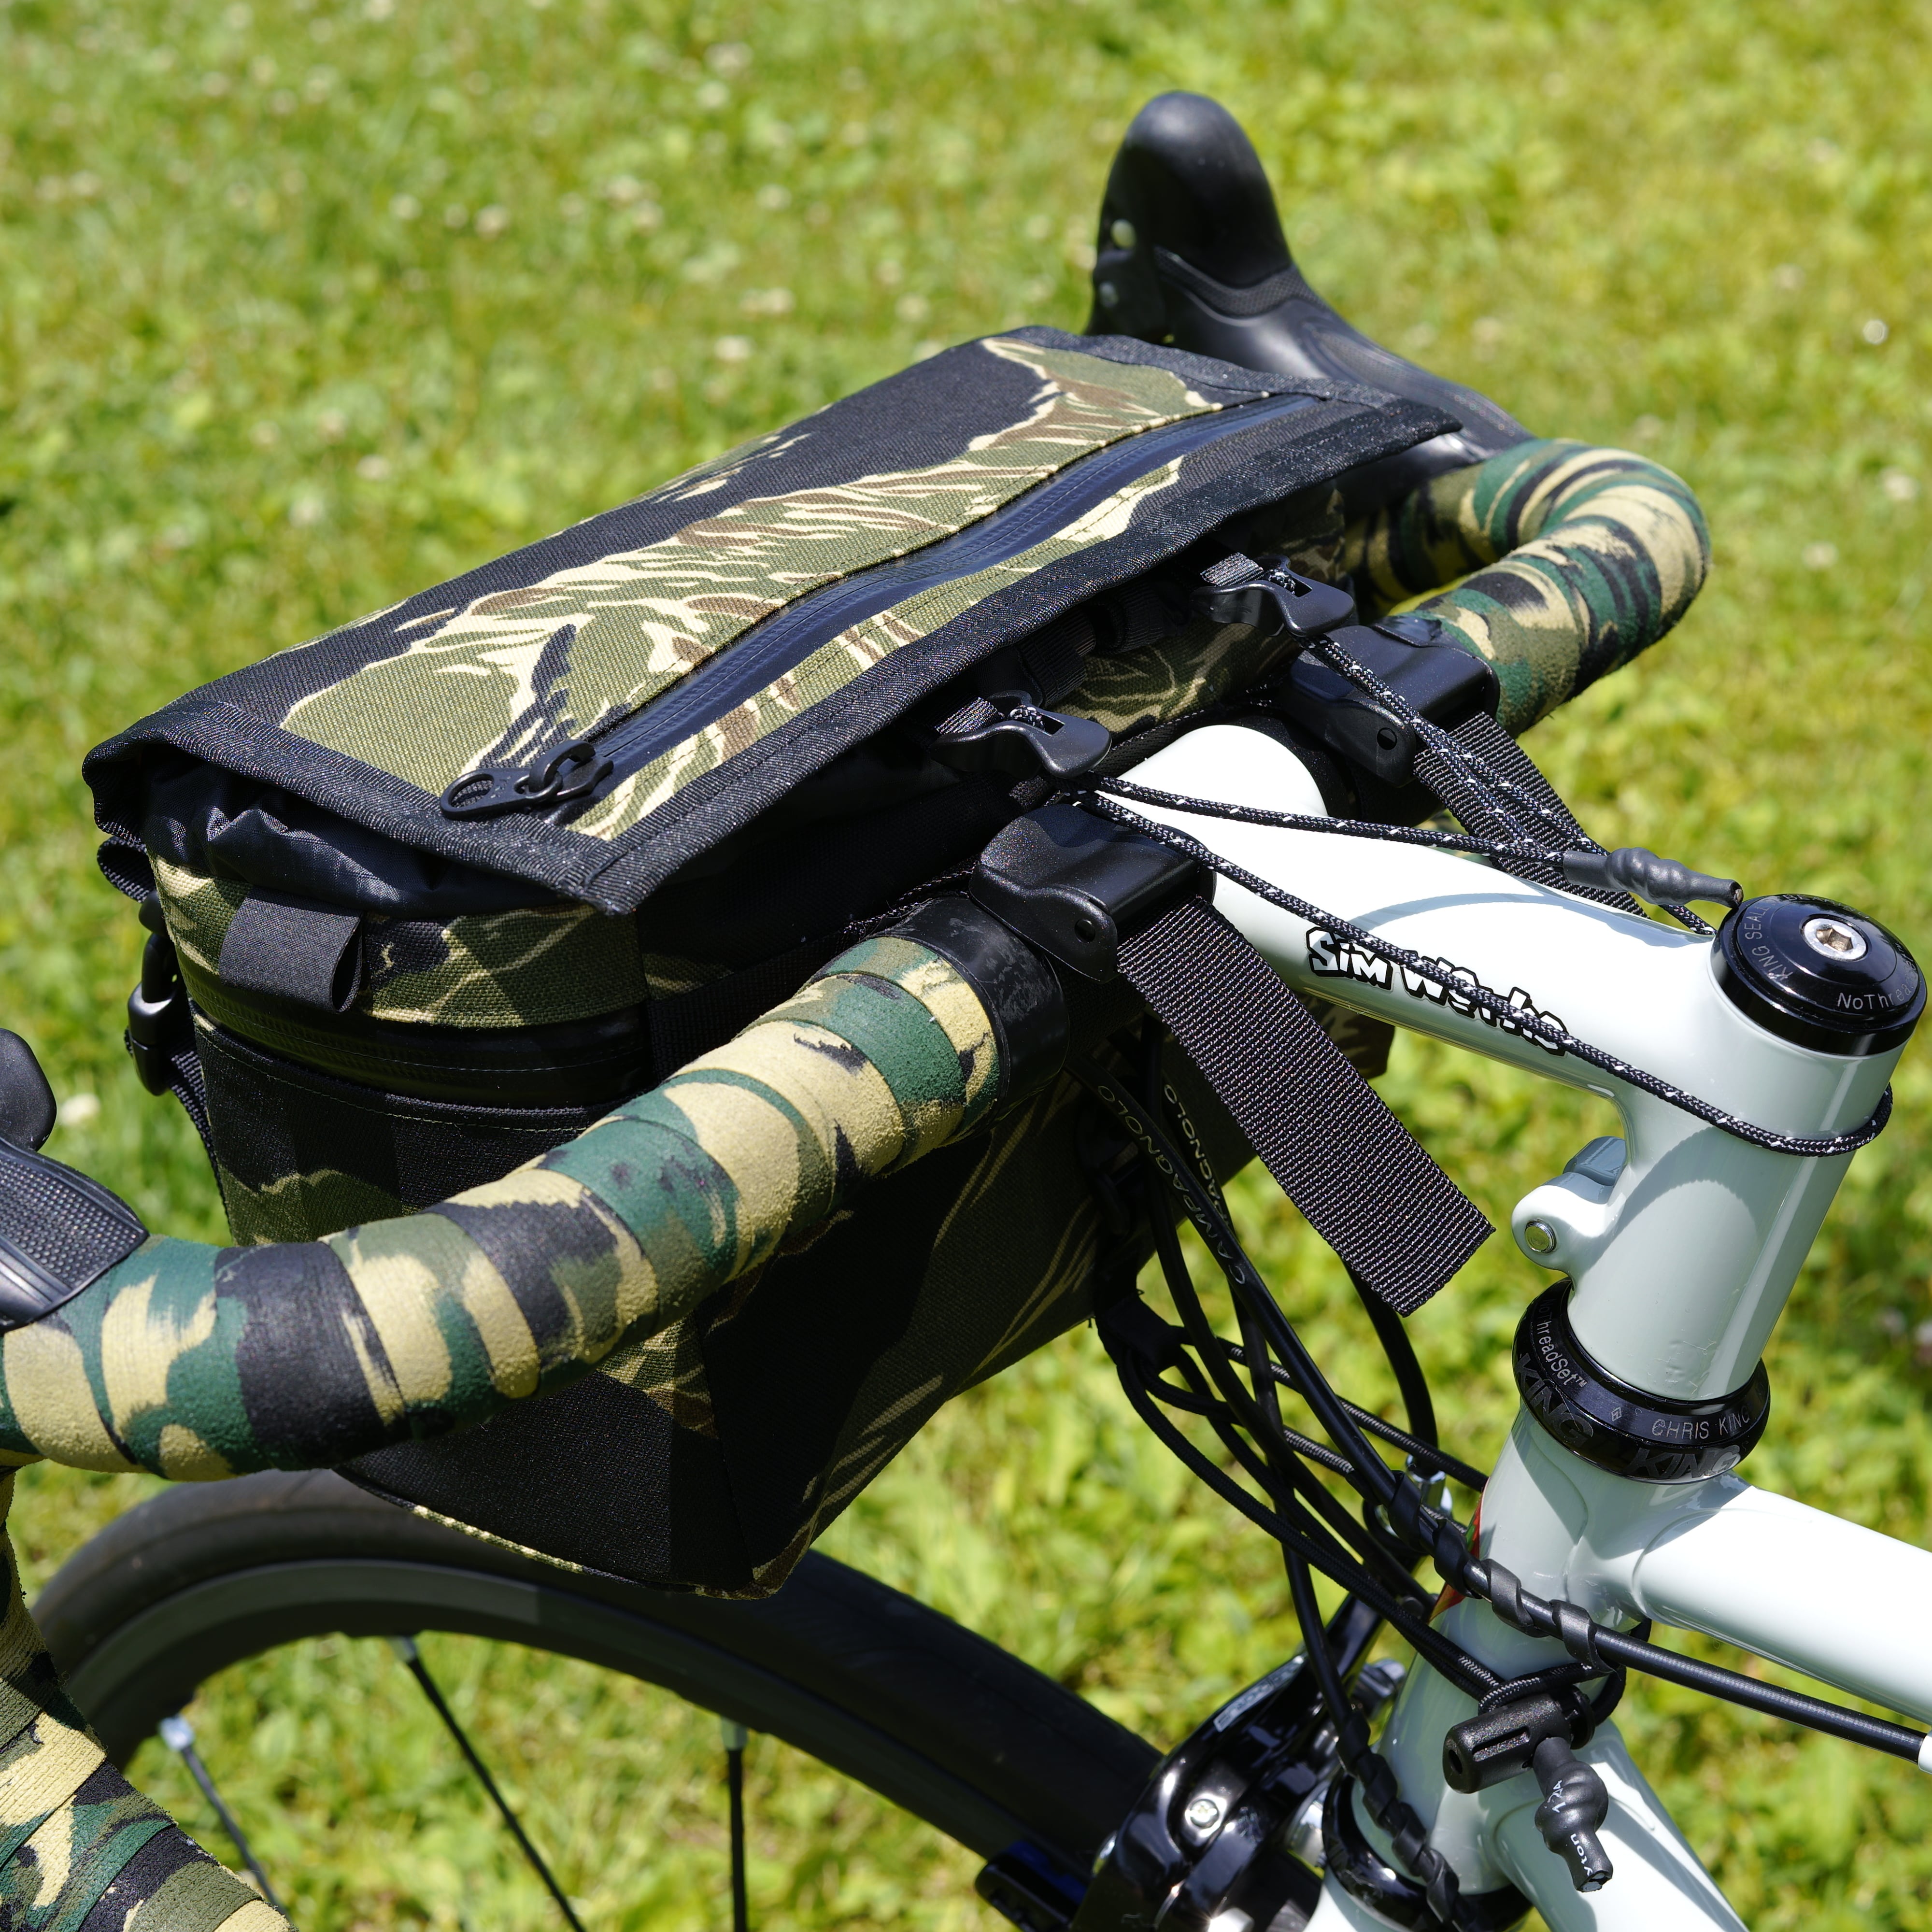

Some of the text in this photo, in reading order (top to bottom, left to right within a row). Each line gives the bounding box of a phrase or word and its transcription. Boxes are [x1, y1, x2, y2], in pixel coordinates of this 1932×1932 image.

[1751, 945, 1794, 981] KING
[1098, 1085, 1245, 1284] CAMPAGNOLO
[1514, 1353, 1594, 1447] KING
[1651, 1406, 1750, 1441] CHRIS KING
[1624, 1444, 1741, 1480] KING
